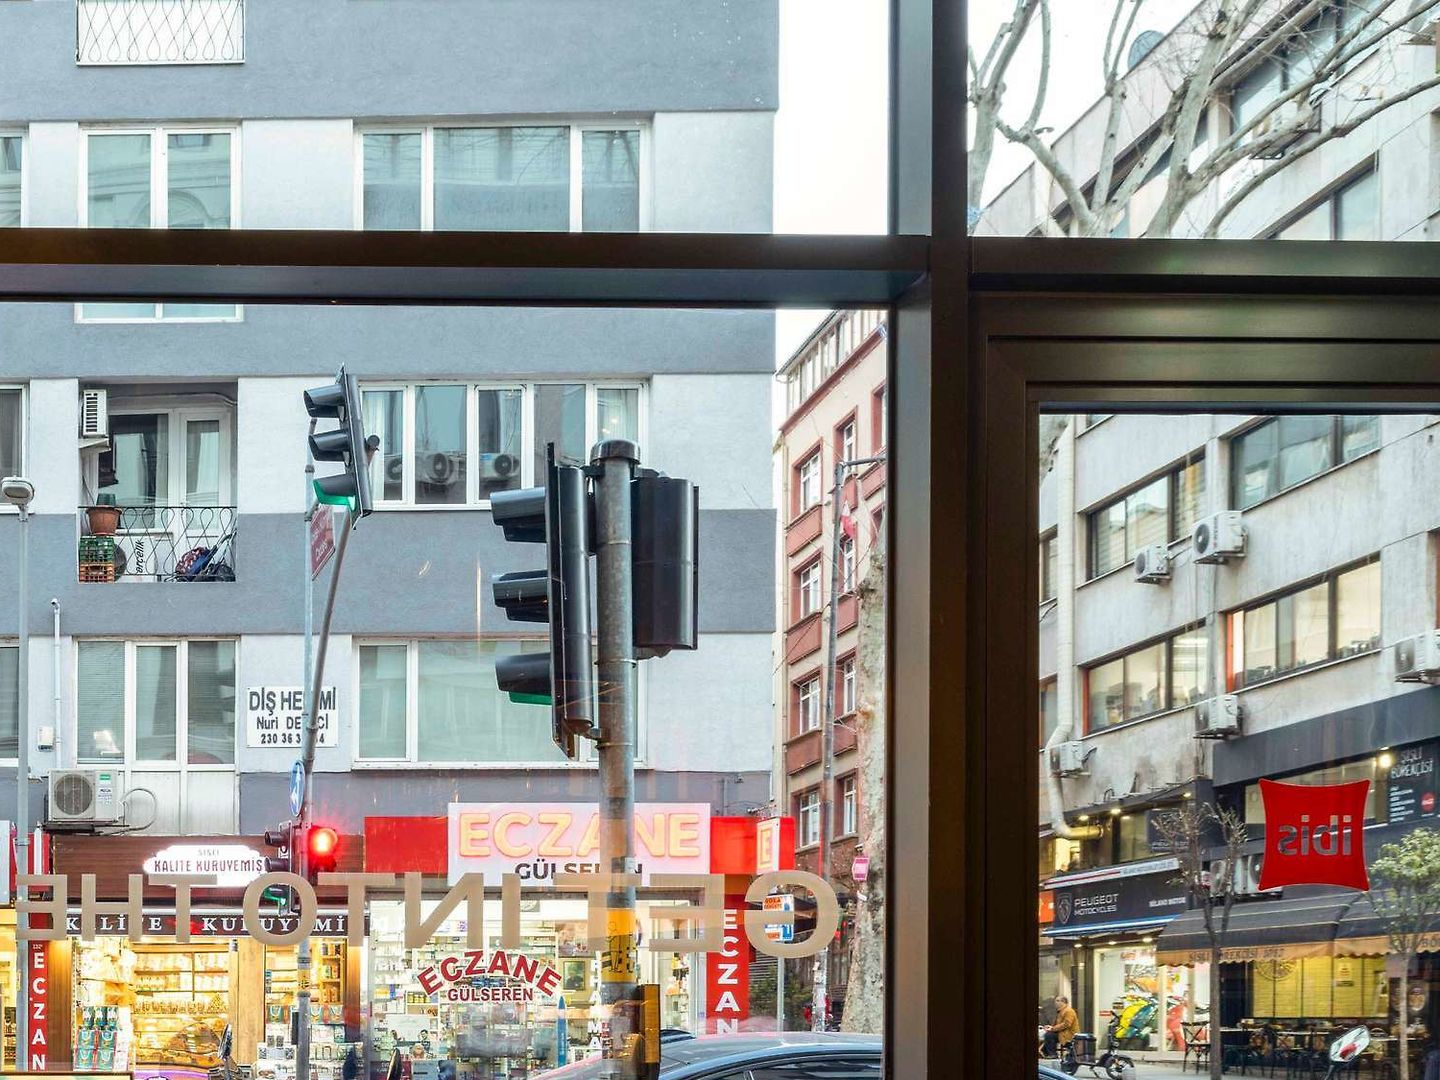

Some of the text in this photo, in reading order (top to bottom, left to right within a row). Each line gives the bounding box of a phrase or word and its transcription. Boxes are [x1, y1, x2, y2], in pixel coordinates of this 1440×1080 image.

[249, 687, 336, 716] DİŞ HEMİ
[256, 713, 328, 730] Nuri DECİ
[261, 733, 278, 744] 230
[1074, 893, 1119, 907] PEUGEOT
[66, 914, 345, 932] KLİE KUUYMİ
[417, 950, 562, 997] ECZANE
[447, 985, 534, 1001] GÜLSEREN
